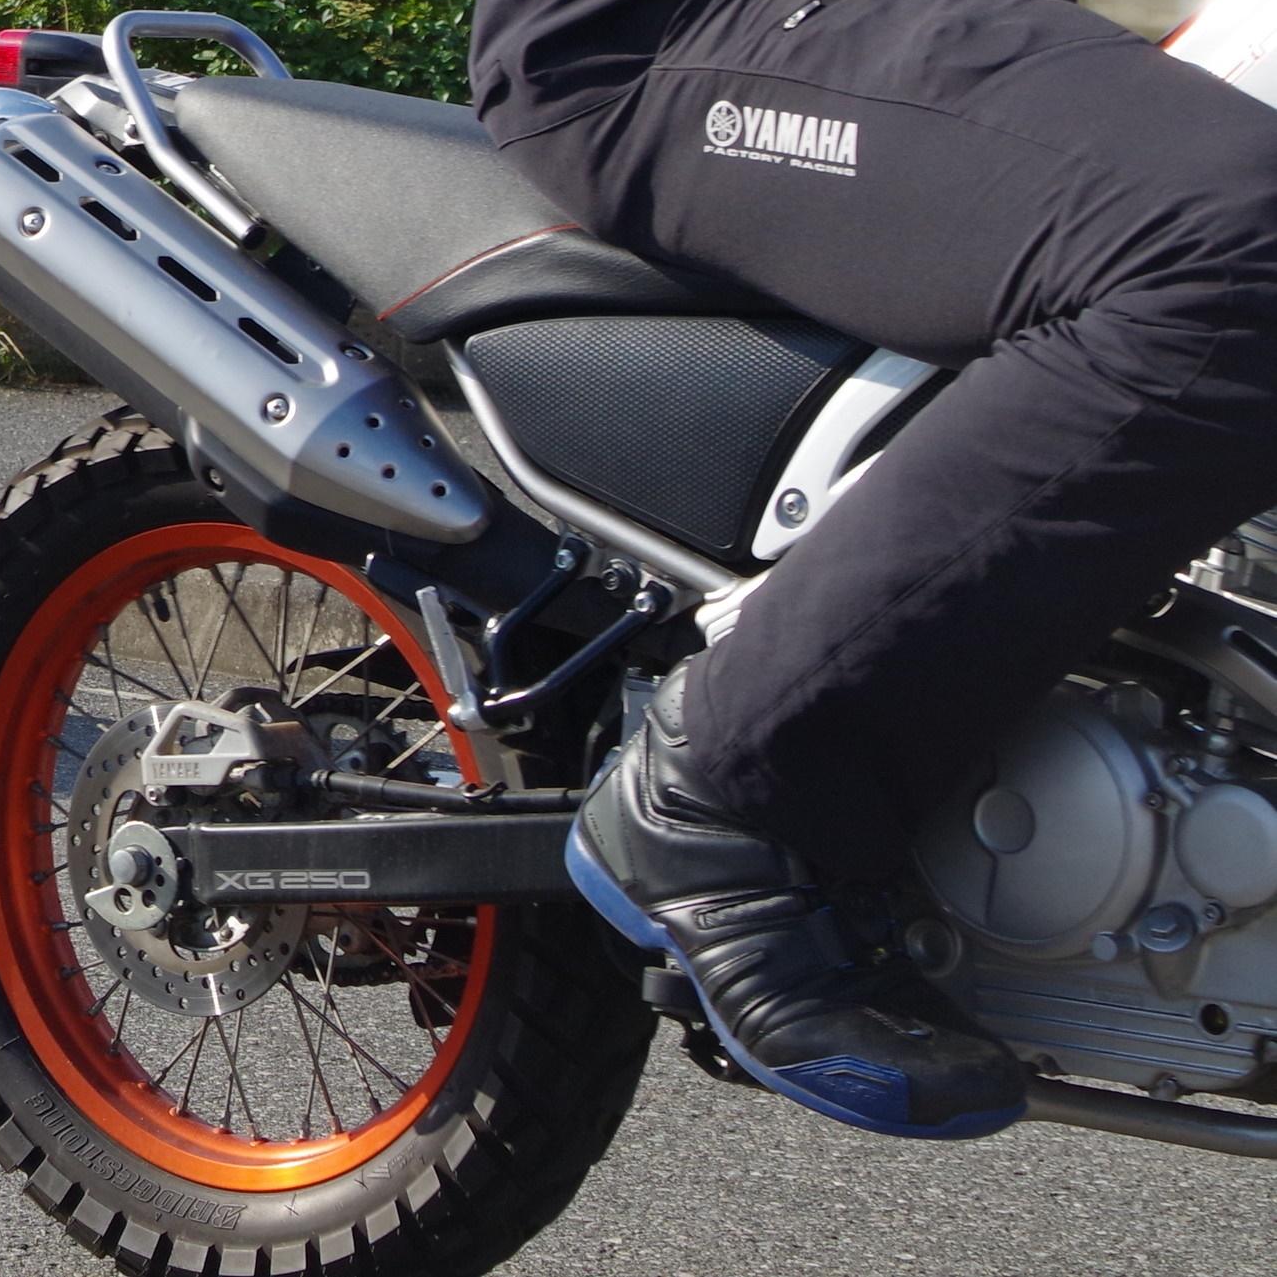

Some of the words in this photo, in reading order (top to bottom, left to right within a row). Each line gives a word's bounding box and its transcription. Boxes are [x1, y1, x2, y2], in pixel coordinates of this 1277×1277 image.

[703, 145, 785, 164] FACTORY
[790, 158, 857, 177] RACING
[743, 106, 858, 165] YAMAHA
[24, 1091, 248, 1230] BRIDGESTONE
